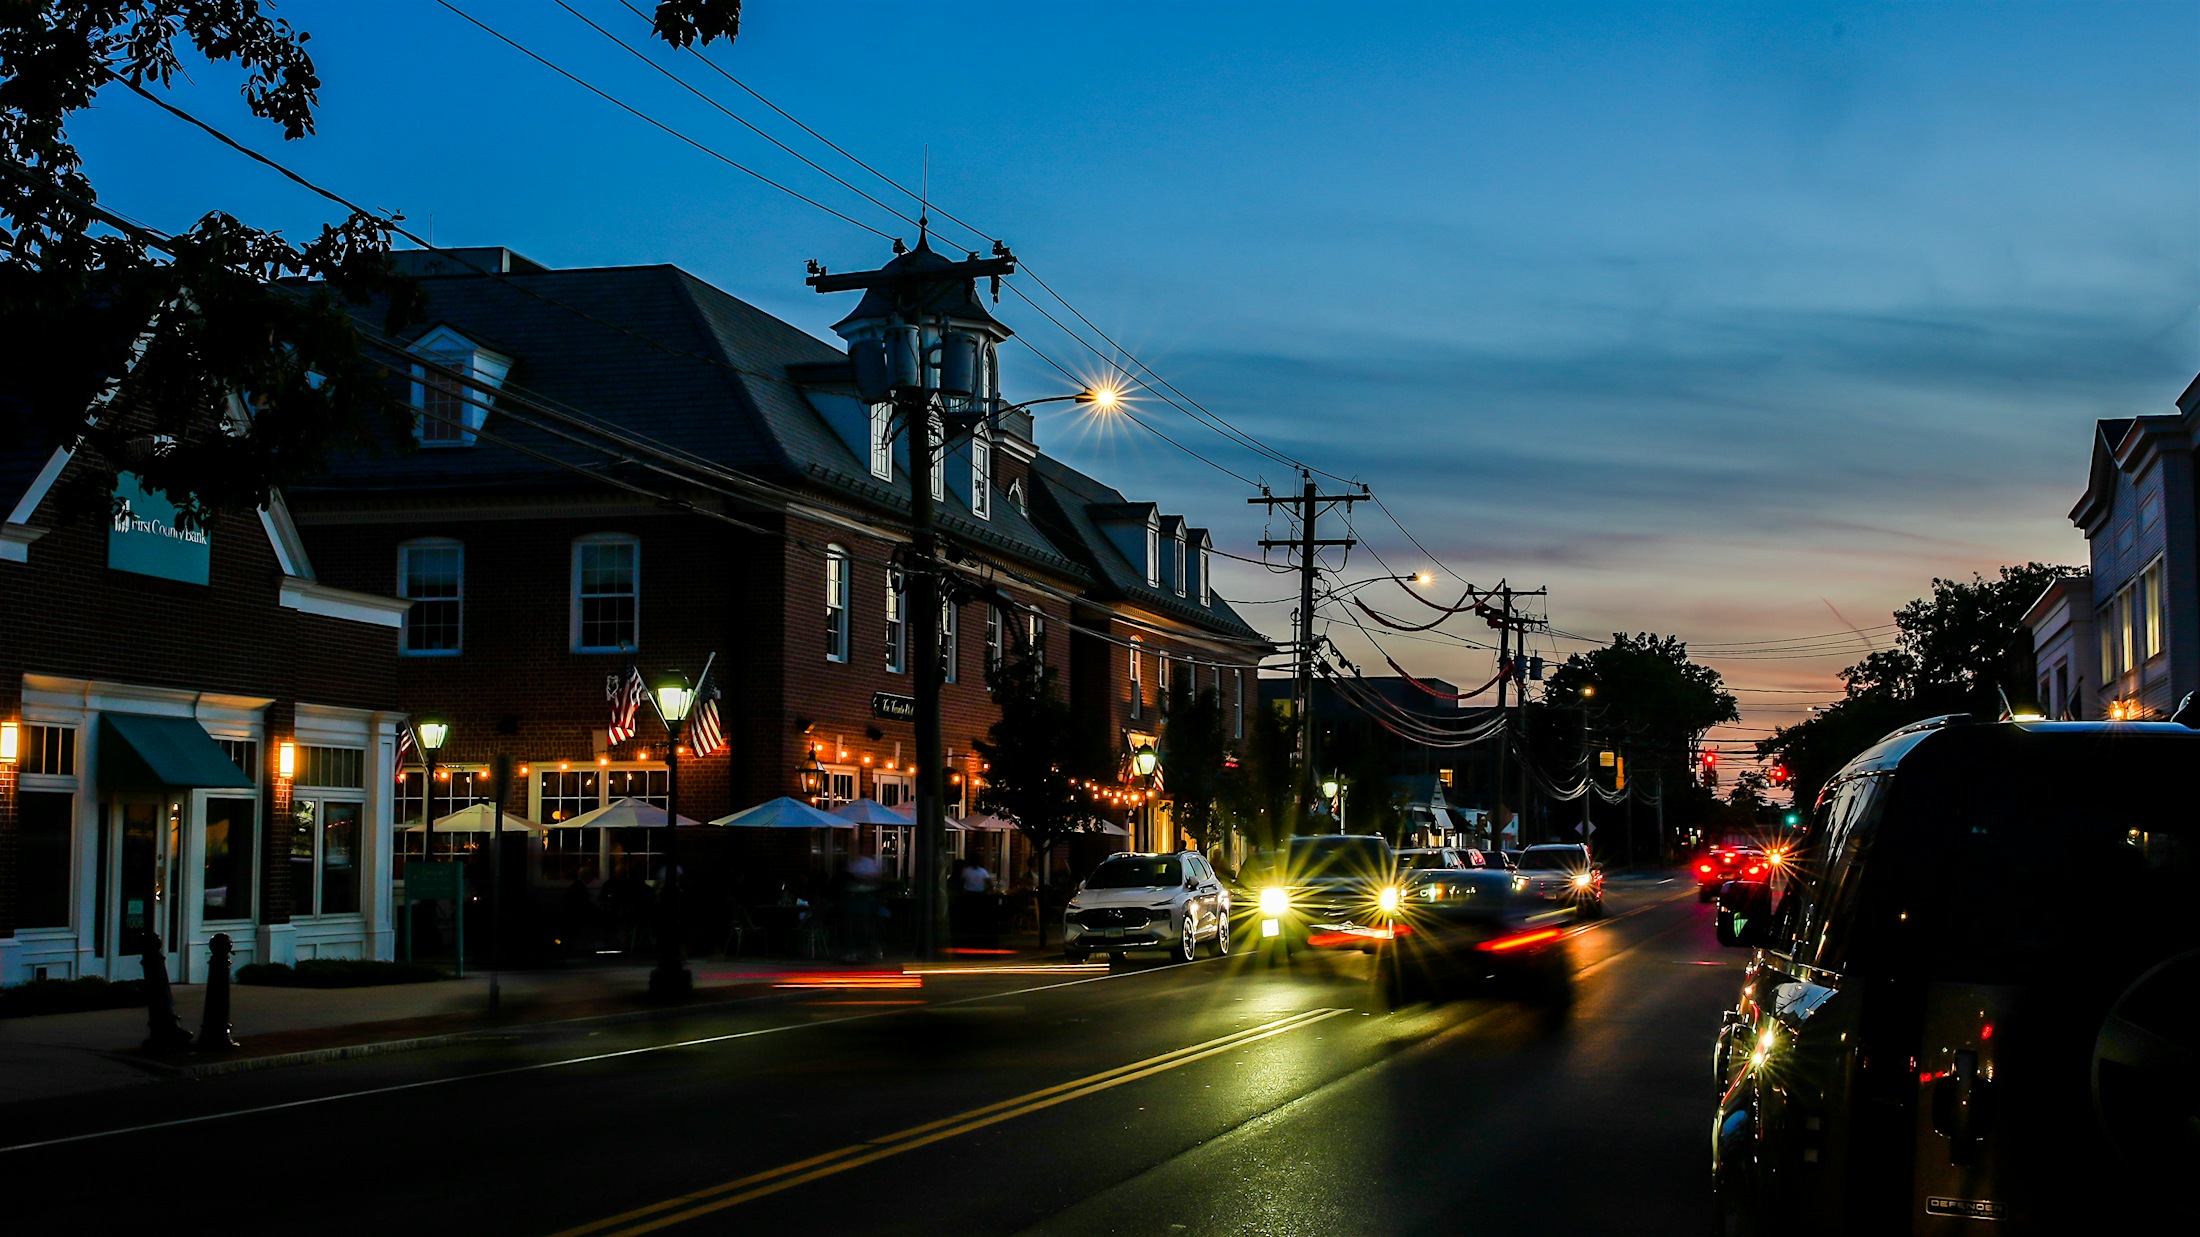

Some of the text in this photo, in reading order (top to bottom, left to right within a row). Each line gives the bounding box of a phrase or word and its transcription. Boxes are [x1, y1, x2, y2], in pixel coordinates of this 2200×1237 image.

[131, 513, 150, 533] First
[152, 519, 184, 543] County
[126, 917, 144, 929] 1006
[1931, 1200, 2002, 1212] DEFENDER
